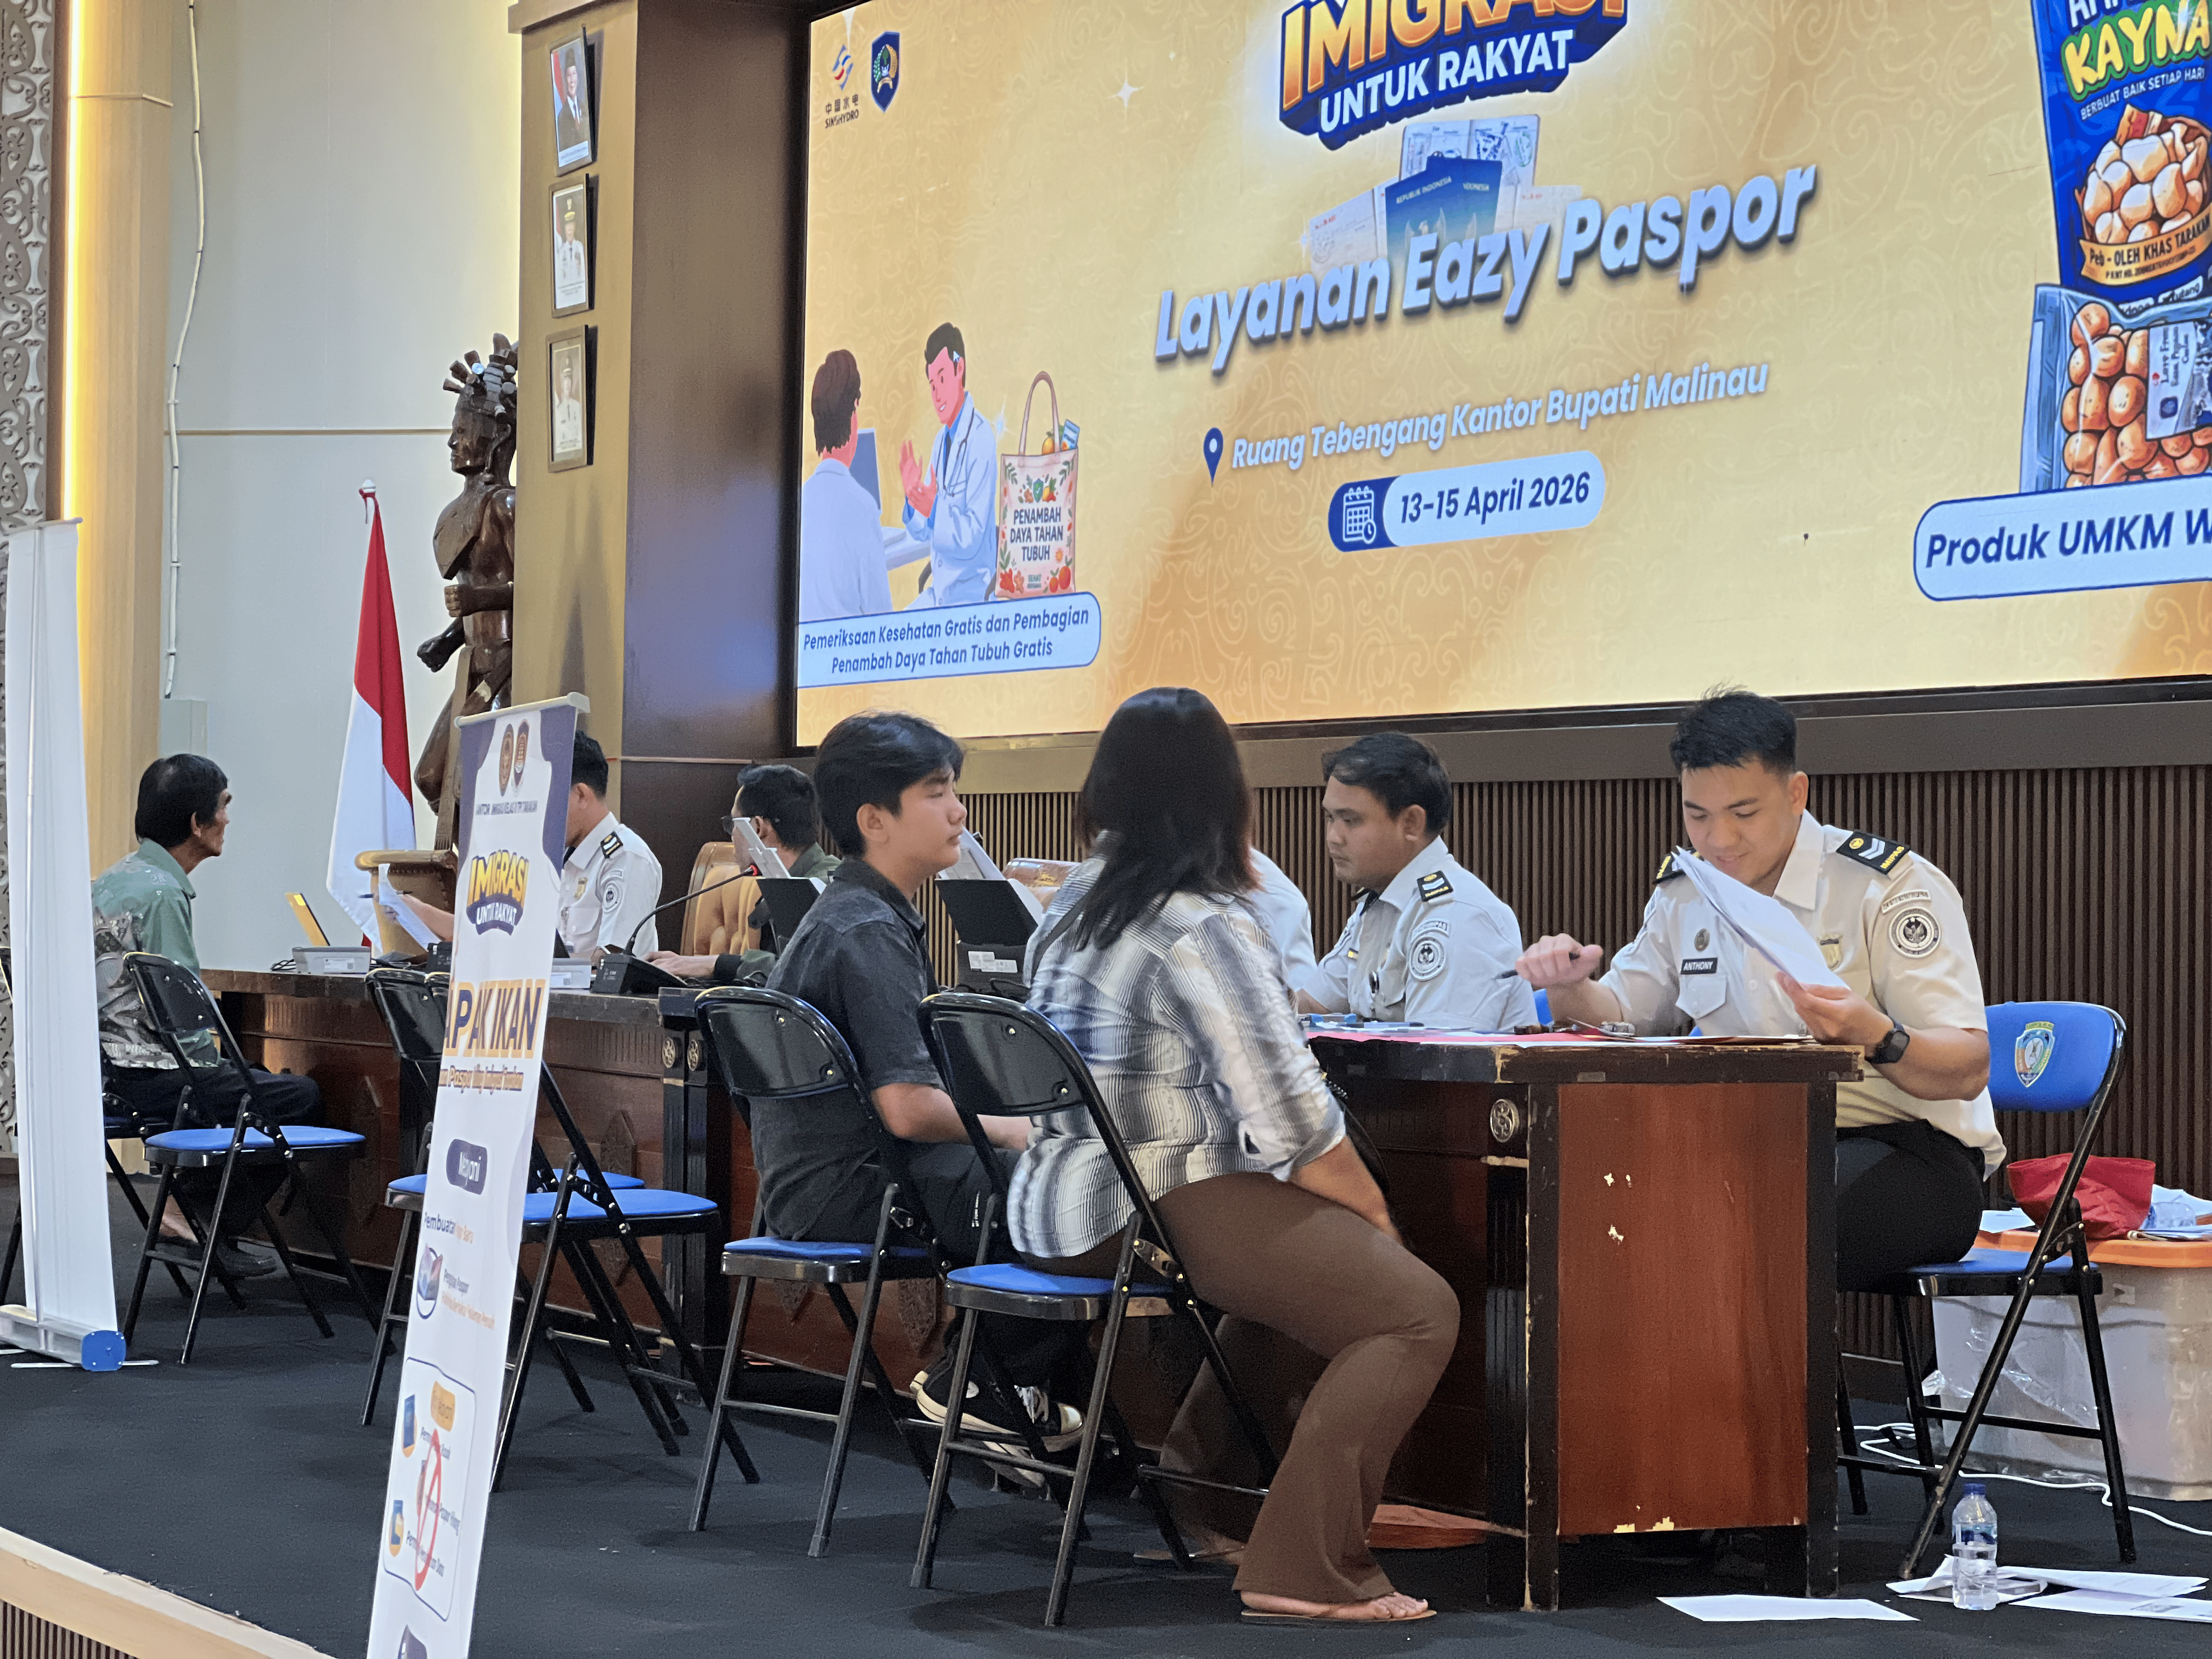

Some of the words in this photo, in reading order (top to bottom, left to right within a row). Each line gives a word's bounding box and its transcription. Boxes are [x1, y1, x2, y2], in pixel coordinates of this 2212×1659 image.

[1283, 0, 1625, 110] IMIG
[1321, 57, 1430, 132] UNTUK
[1438, 29, 1573, 92] RAKYAT
[2080, 89, 2120, 120] BERBUAT
[2123, 81, 2146, 99] BAIK
[2148, 70, 2182, 91] SETIAP
[2184, 67, 2205, 81] HARI
[825, 94, 859, 115] 中国水电
[1396, 189, 1421, 204] REPUBLIK
[1422, 176, 1452, 194] INDONESIA
[1155, 254, 1391, 371] Layanan
[1403, 224, 1550, 321] Eazy
[1558, 165, 1816, 291] Paspor
[2114, 247, 2140, 266] OLEH
[2144, 237, 2172, 262] KHAS
[1232, 430, 1305, 469] Ruang
[1311, 411, 1447, 457] Tebengang
[1453, 394, 1543, 437] Kantor
[1546, 374, 1641, 428] Bupati
[1644, 362, 1770, 409] Malinau
[1014, 506, 1061, 525] PENAMBAH
[1401, 484, 1460, 523] 13-15
[1465, 477, 1523, 525] April
[1530, 471, 1590, 507] 2026
[1011, 527, 1032, 544] DAYA
[1035, 525, 1063, 542] TAHAN
[1022, 545, 1050, 561] TUBUH
[1926, 523, 2050, 568] Produk
[2059, 511, 2175, 557] UMKM
[803, 627, 876, 651] Pemeriksaan
[878, 620, 941, 644] Kesehatan
[945, 614, 983, 636] Gratis
[986, 614, 1010, 634] dan
[1013, 605, 1089, 637] Pembagian
[832, 648, 893, 674] Penambah
[895, 648, 926, 673] Daya
[929, 645, 967, 665] Tahan
[971, 641, 1010, 662] Tubuh
[1013, 636, 1053, 658] Gratis
[466, 850, 529, 907] IMIGRASI
[494, 902, 517, 927] RAKYAT
[1683, 961, 1713, 971] ANTHONY
[489, 984, 543, 1054] IKAN
